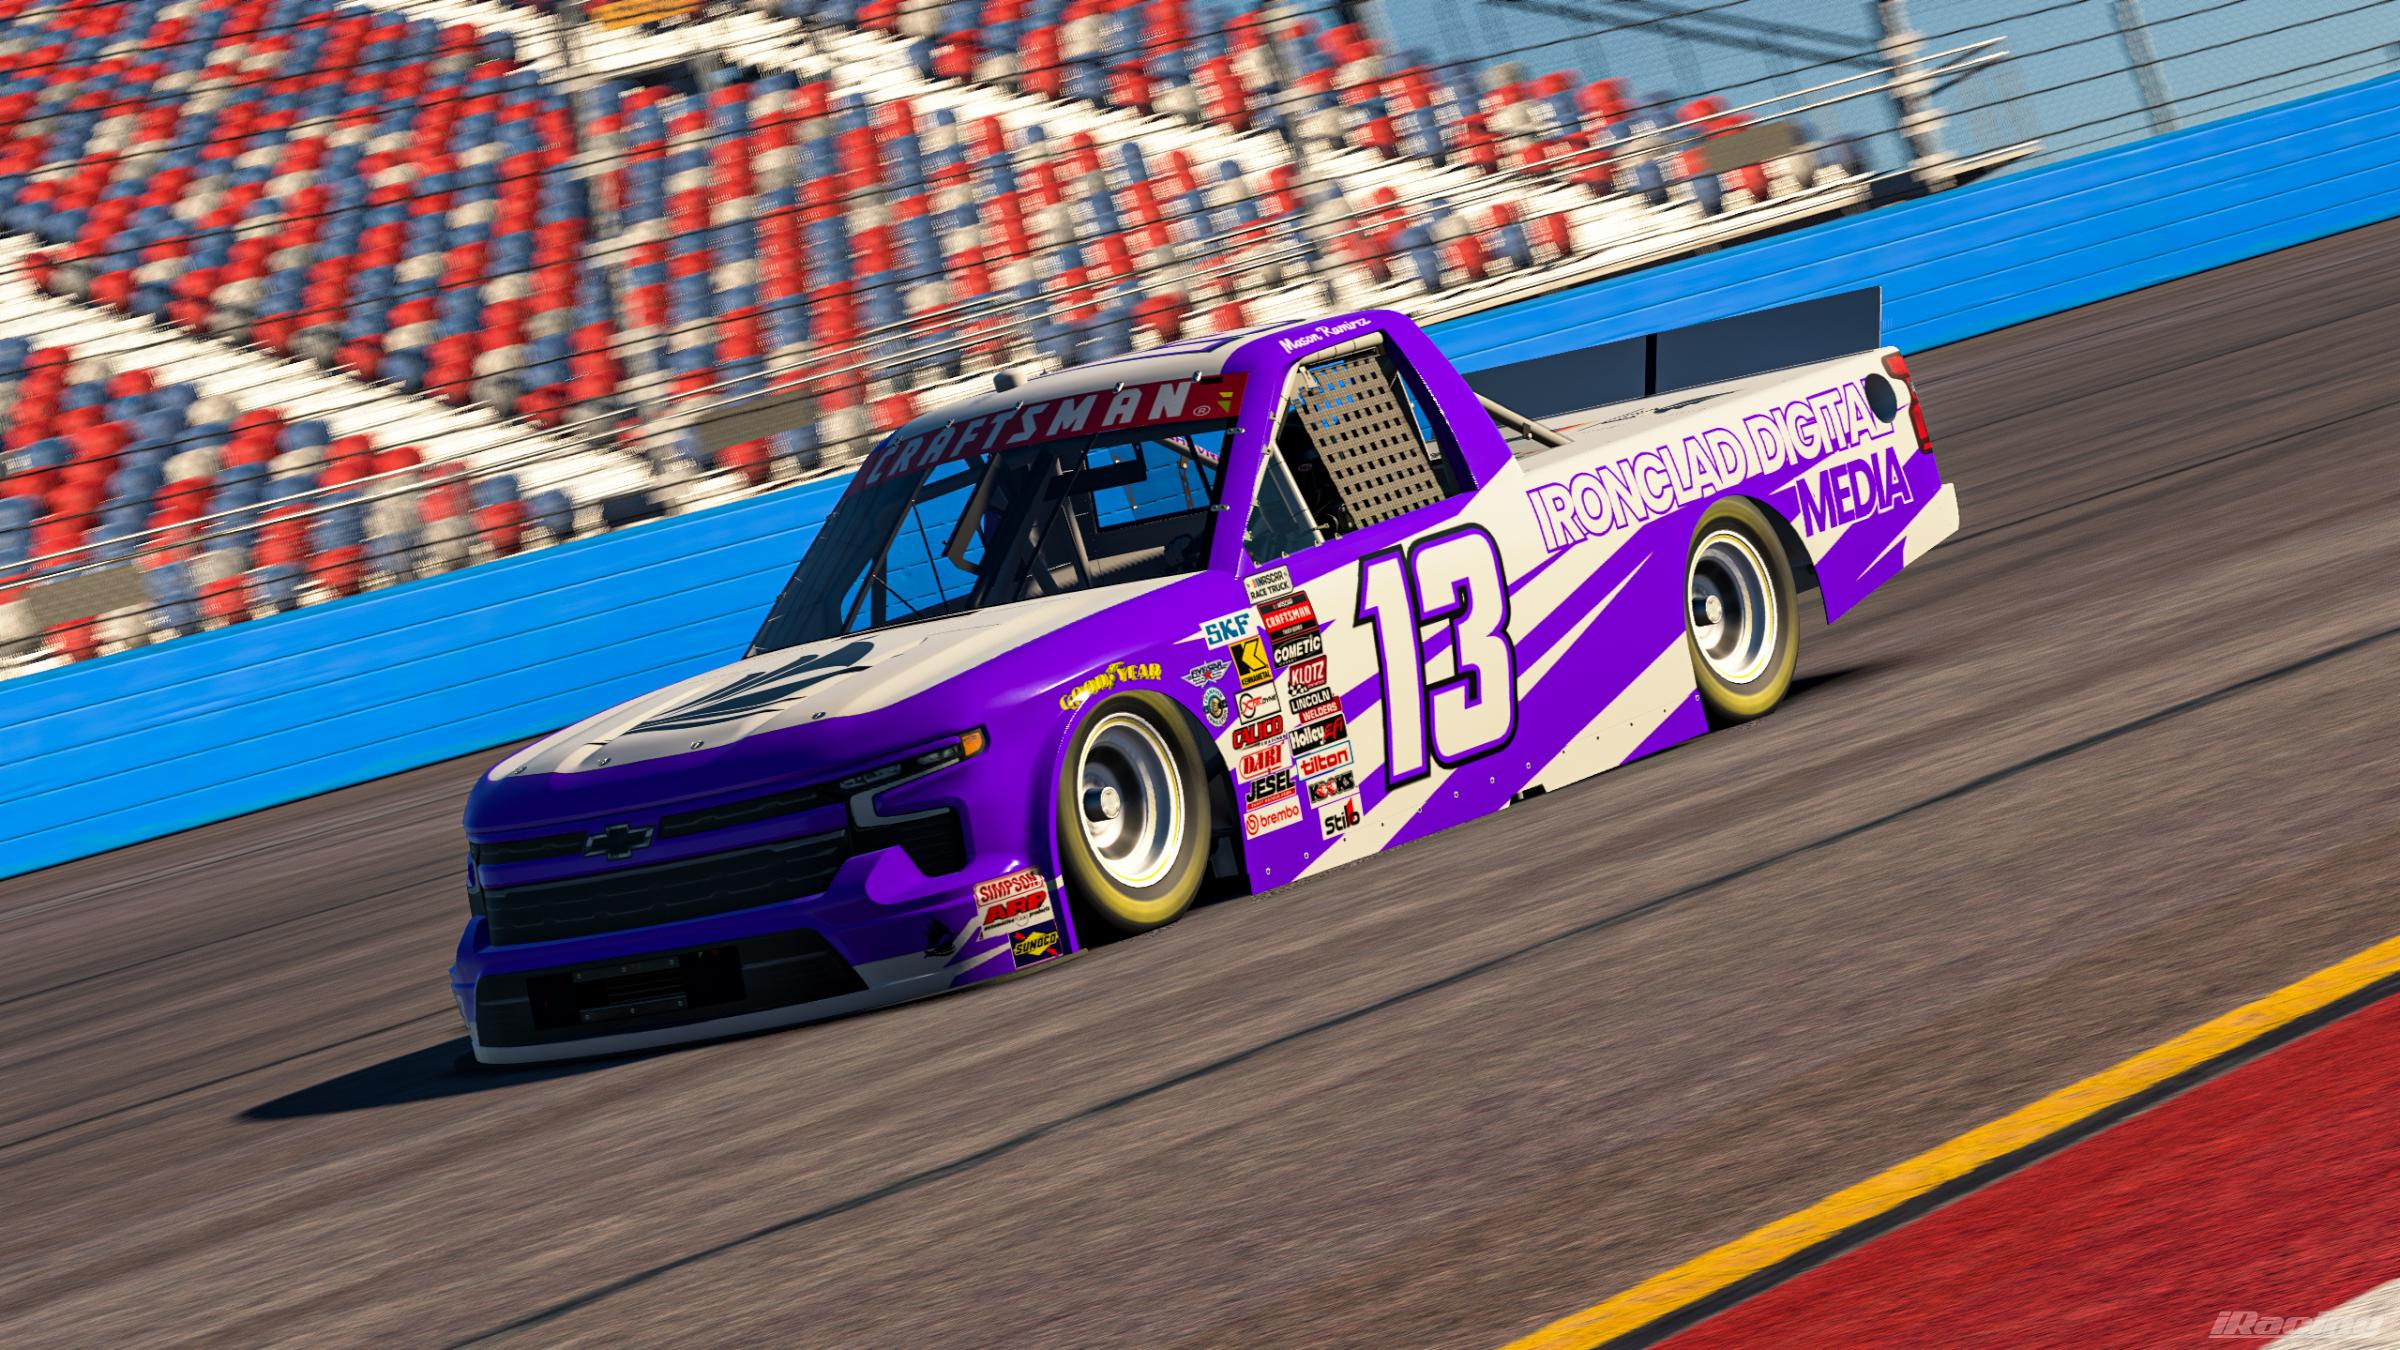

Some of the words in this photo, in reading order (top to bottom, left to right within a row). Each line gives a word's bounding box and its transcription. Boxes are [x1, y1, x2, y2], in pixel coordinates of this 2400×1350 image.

[1278, 334, 1323, 354] Mason
[866, 381, 1195, 485] CRAFTSMAN
[1527, 427, 1748, 553] IRONCLAD
[1796, 446, 1914, 537] MEDIA
[1250, 586, 1268, 600] RACE
[1268, 581, 1290, 595] TRUCK
[1255, 570, 1284, 588] NASCAR
[1204, 612, 1250, 646] SKF
[1265, 605, 1312, 628] CRAFTSMAN
[1274, 634, 1321, 663] COMETIC
[1353, 522, 1519, 792] 13
[1291, 661, 1325, 686] KLOTZ
[1291, 689, 1331, 713] LINCOLN
[1302, 702, 1338, 721] WELDERS
[1232, 714, 1284, 751] CALICO
[1289, 724, 1325, 750] Holley
[1300, 747, 1349, 777] tilton
[1246, 769, 1296, 803] JESEL
[1308, 771, 1355, 804] KOOKS
[1260, 803, 1300, 828] brembo
[1324, 798, 1361, 836] Stilo
[979, 871, 1039, 903] SIMPSON
[983, 890, 1047, 926] ARP
[1015, 933, 1057, 955] SUNOCO
